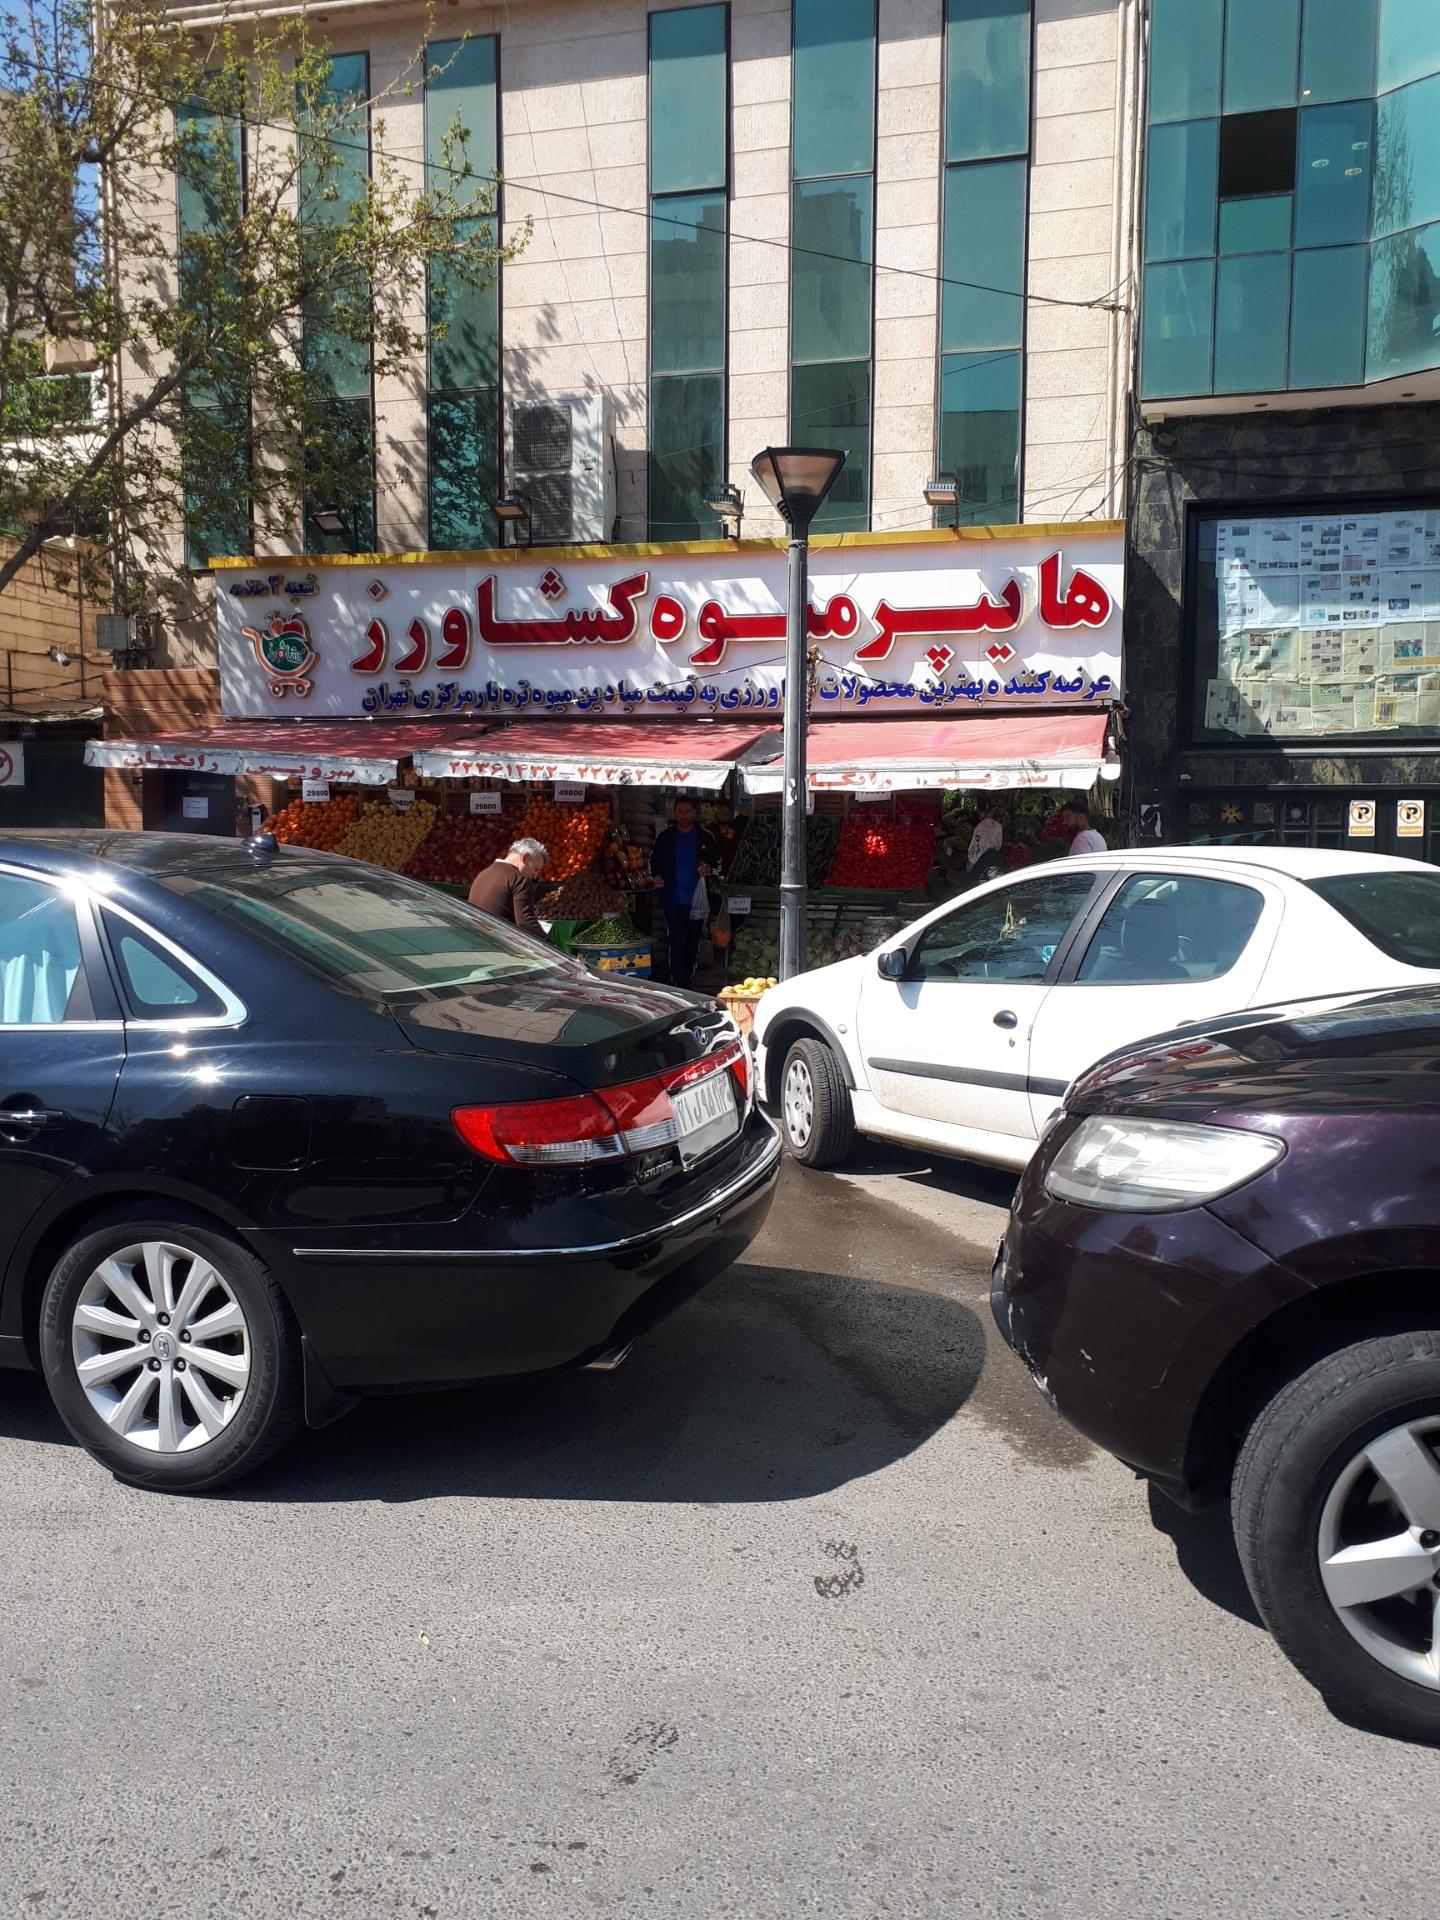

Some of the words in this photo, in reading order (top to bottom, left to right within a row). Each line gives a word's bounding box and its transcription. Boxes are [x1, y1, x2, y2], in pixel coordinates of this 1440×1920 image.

[350, 566, 651, 674] کشاورز
[854, 549, 1113, 675] هایپر
[362, 679, 411, 712] تهران
[646, 681, 697, 713] قیمت
[699, 683, 718, 713] به
[819, 675, 917, 706] محصولات
[987, 668, 1052, 697] کننده
[1052, 666, 1112, 699] عرضه
[558, 788, 583, 797] 49800
